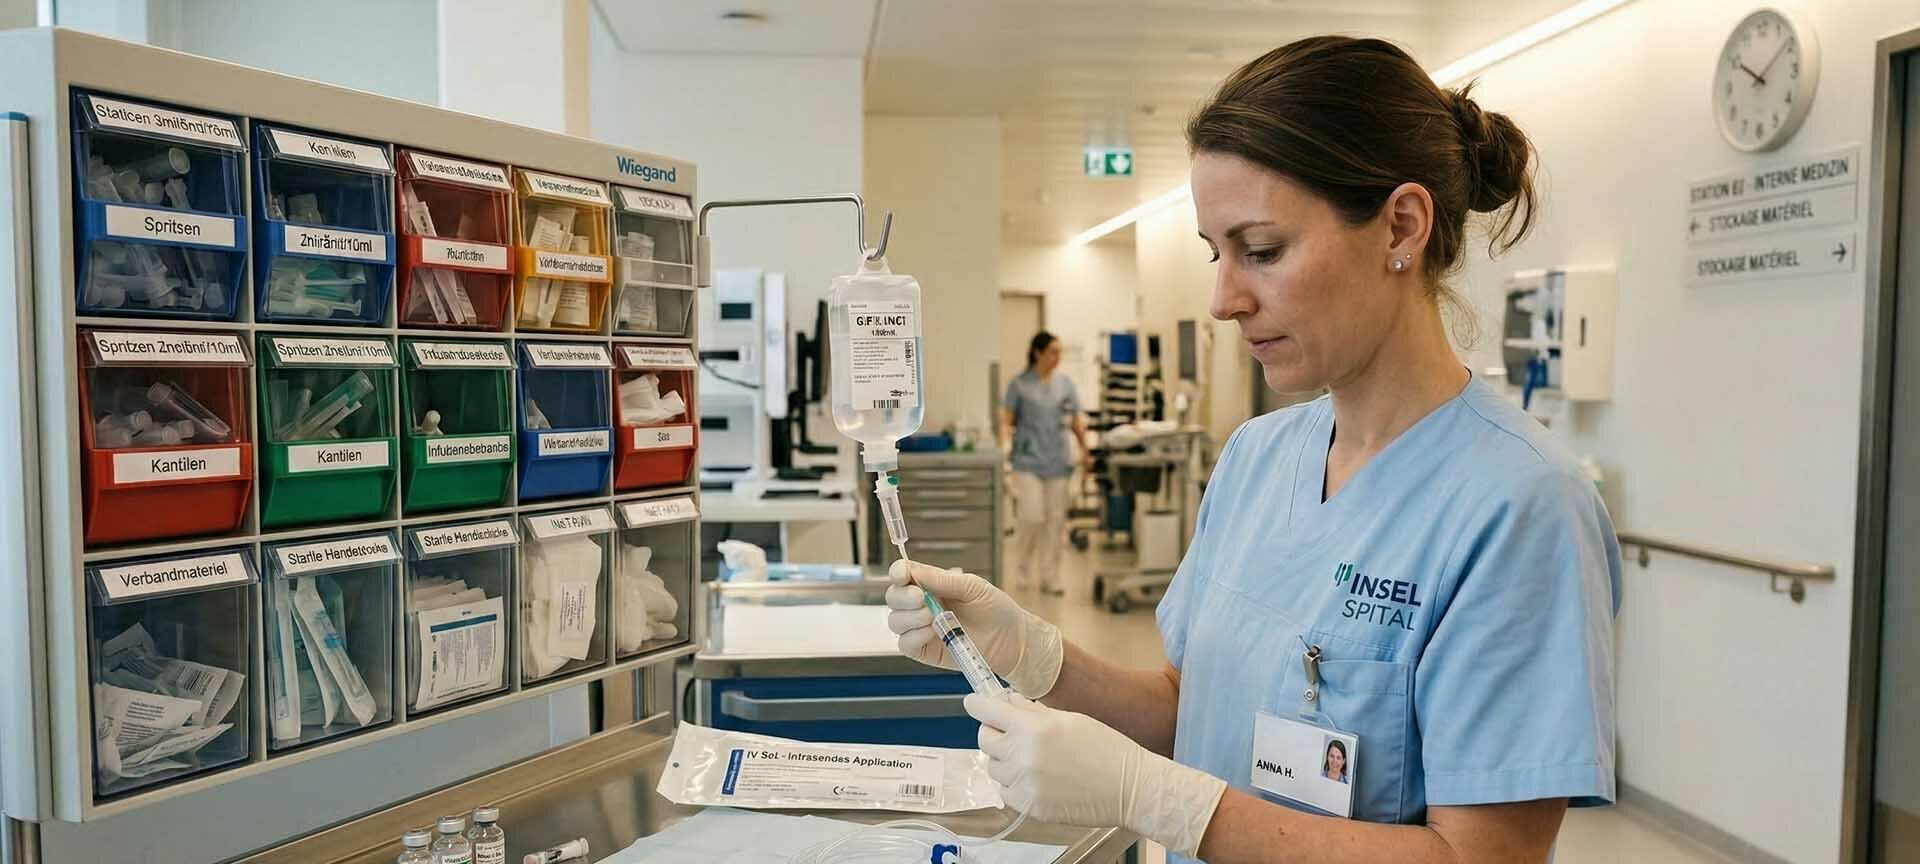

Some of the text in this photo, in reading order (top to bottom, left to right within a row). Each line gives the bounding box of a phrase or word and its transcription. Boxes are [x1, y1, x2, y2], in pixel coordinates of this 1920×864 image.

[616, 155, 676, 183] Wiegand
[1753, 165, 1798, 191] INTERNE
[1800, 156, 1849, 181] MEDIZIN
[144, 216, 201, 237] Spritsen
[1709, 208, 1759, 232] STOCKAGE
[1696, 254, 1746, 276] STOCKAGE
[151, 458, 207, 475] Kantilen
[317, 448, 363, 465] Kantilen
[119, 561, 229, 588] Verbandmateriel
[1349, 573, 1422, 607] INSEL
[1342, 599, 1415, 631] SPITAL
[746, 750, 759, 760] IV
[852, 755, 913, 770] Application
[1256, 759, 1295, 779] ANNA H.
